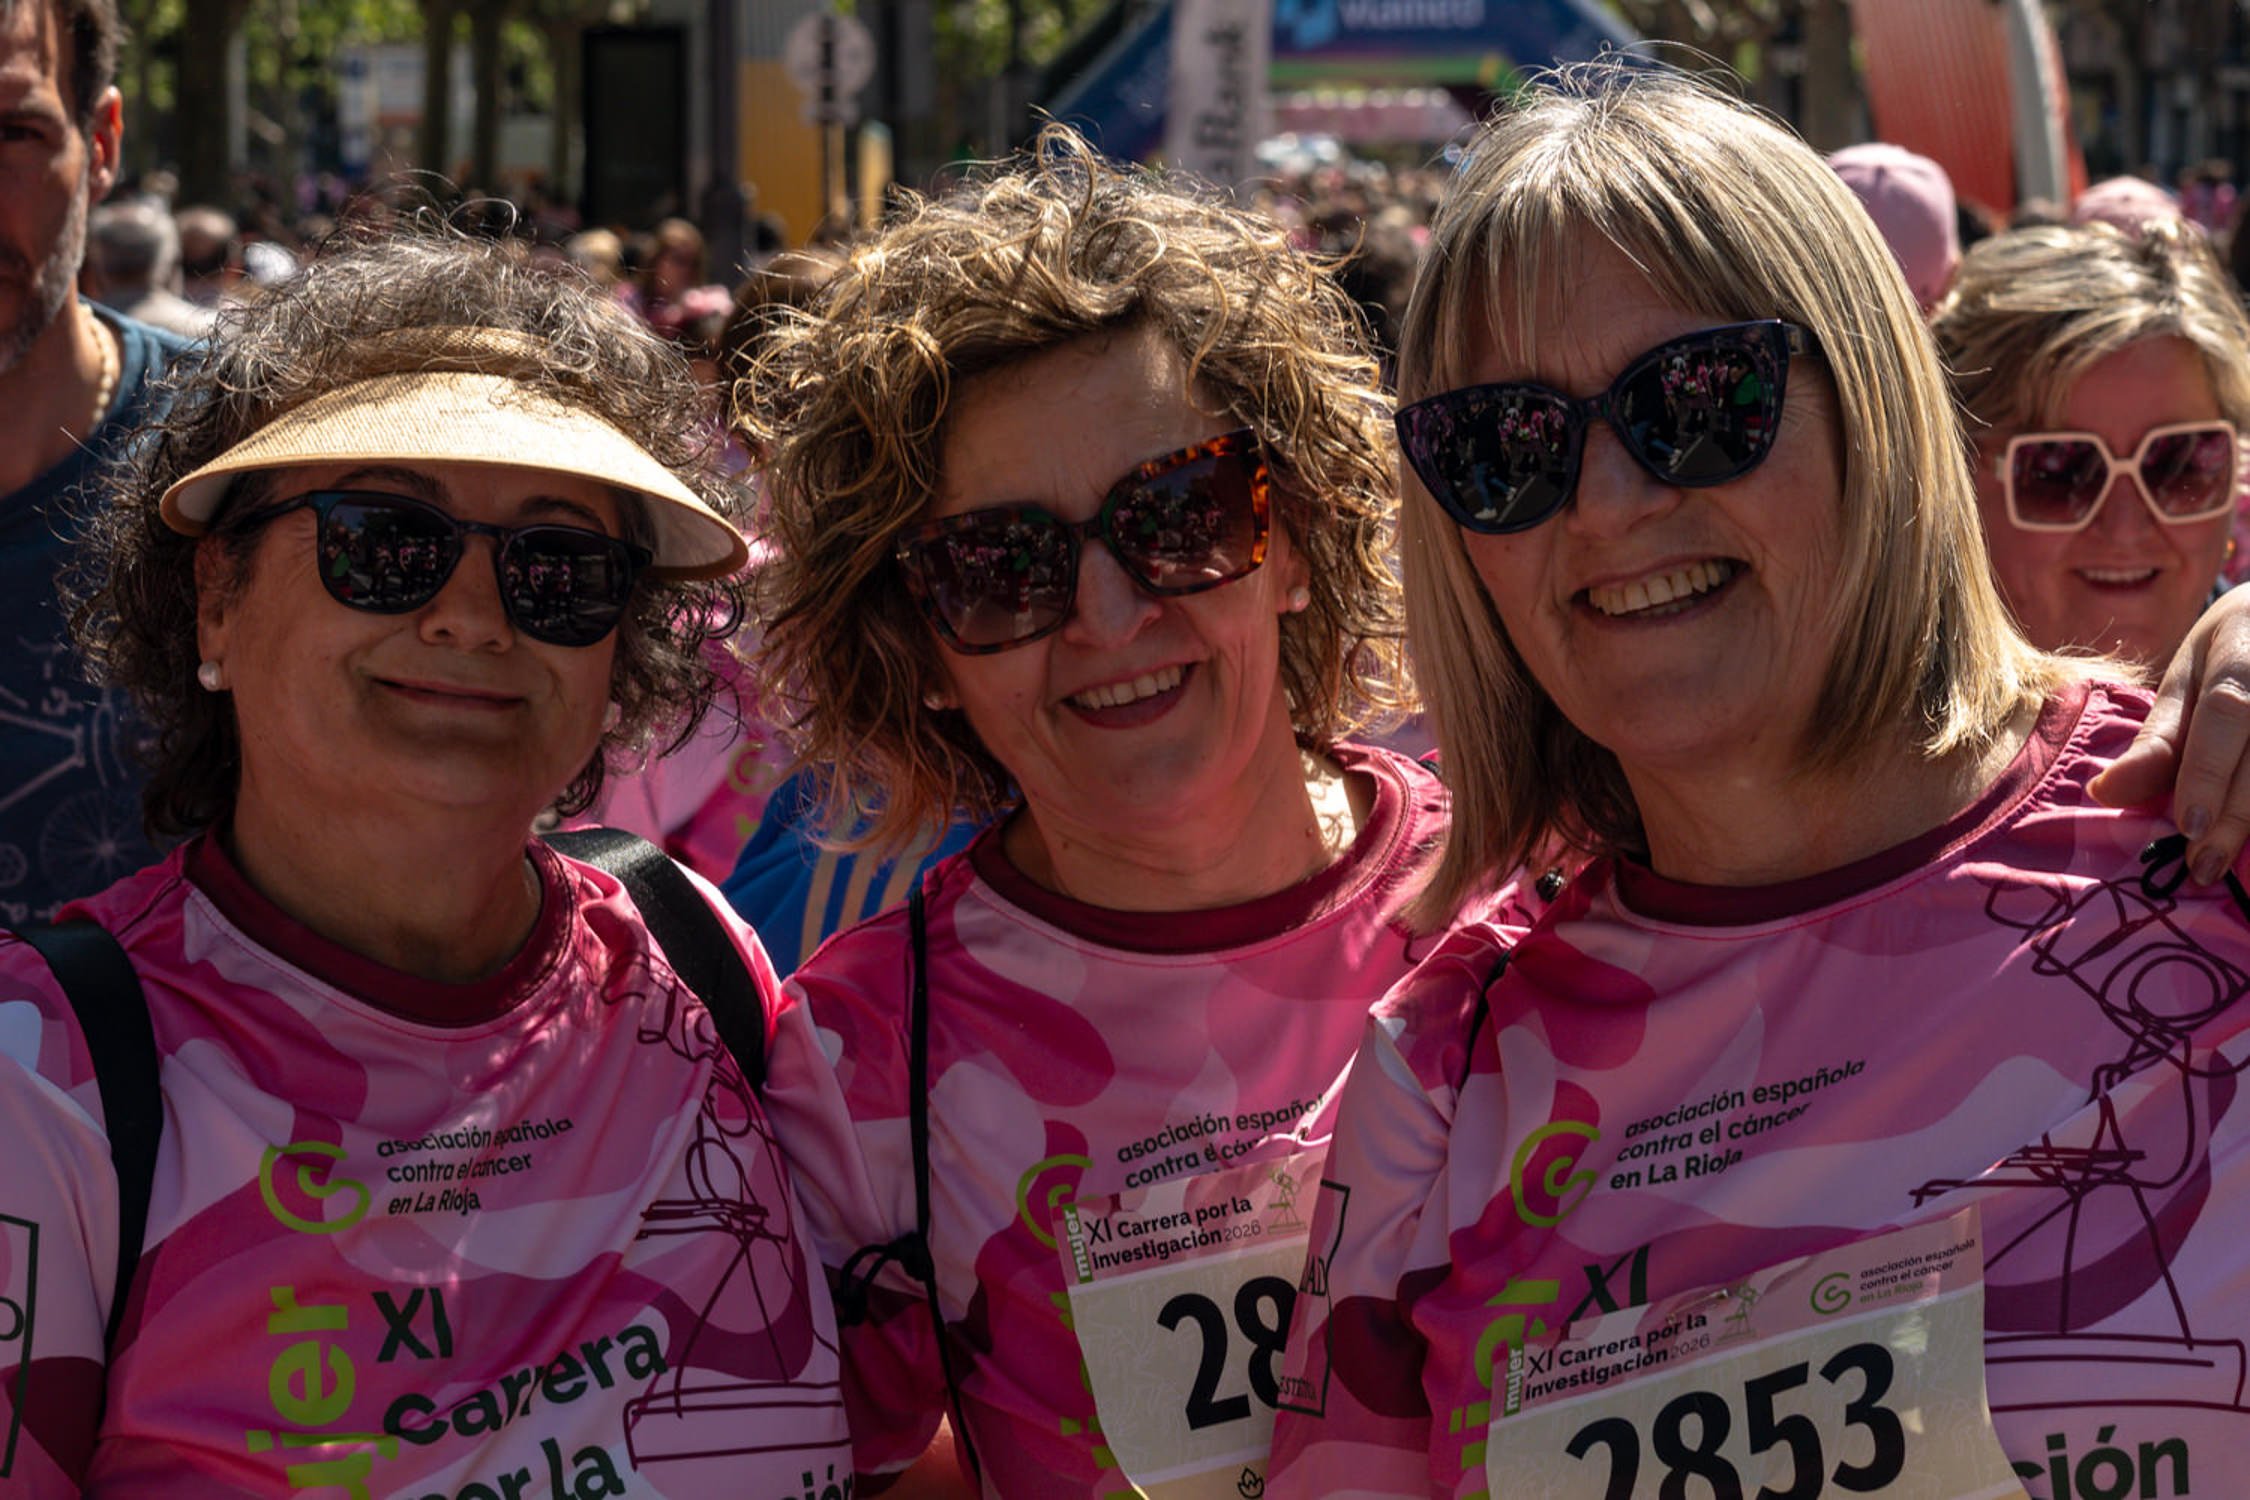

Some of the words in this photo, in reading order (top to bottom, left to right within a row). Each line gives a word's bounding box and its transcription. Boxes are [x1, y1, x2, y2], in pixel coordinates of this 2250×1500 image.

[1625, 1089, 1745, 1139] asociación
[1753, 1061, 1865, 1106] española
[1117, 1112, 1231, 1163] asociación
[1616, 1131, 1692, 1162] contra
[1699, 1121, 1719, 1145] el
[1727, 1102, 1812, 1139] cáncer
[387, 1160, 454, 1182] contra
[1125, 1149, 1200, 1188] contra
[1610, 1171, 1641, 1190] en
[1648, 1163, 1678, 1185] La
[1685, 1149, 1743, 1176] Rioja
[388, 1197, 412, 1215] en
[414, 1191, 434, 1213] La
[438, 1187, 480, 1216] Rioja
[1085, 1217, 1112, 1245] XI
[1117, 1212, 1191, 1238] Carrera
[1195, 1203, 1228, 1227] por
[1232, 1197, 1252, 1213] la
[1063, 1209, 1092, 1279] mujer
[1092, 1228, 1222, 1270] investigación
[1223, 1220, 1261, 1241] 2026
[1568, 1244, 1651, 1321] XI
[372, 1287, 453, 1362] XI
[1527, 1349, 1553, 1378] XI
[1559, 1335, 1641, 1367] Carrera
[1646, 1321, 1682, 1351] por
[1686, 1313, 1707, 1331] la
[1504, 1348, 1524, 1409] mujer
[1525, 1348, 1668, 1400] investigación
[1565, 1343, 1905, 1500] 2853
